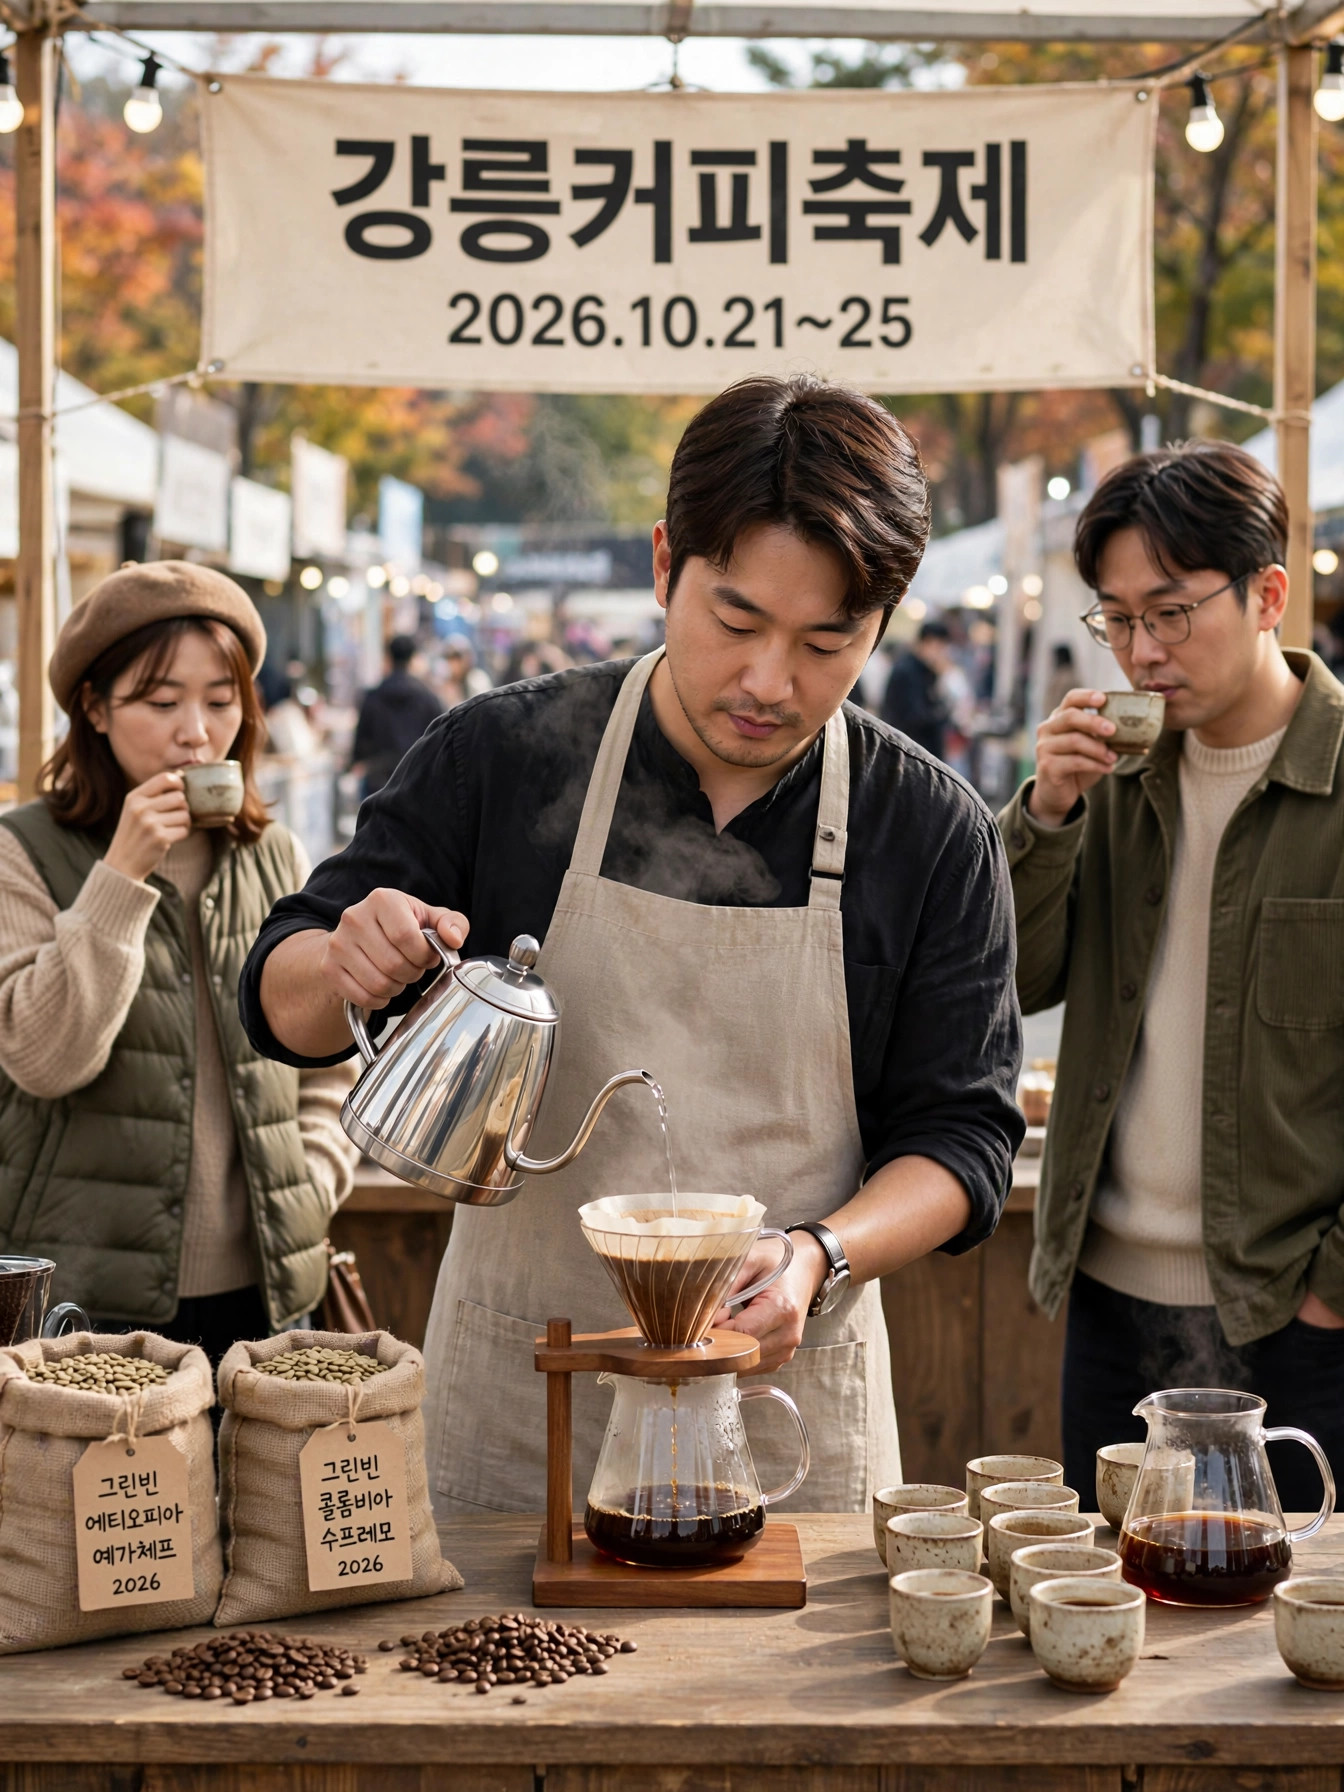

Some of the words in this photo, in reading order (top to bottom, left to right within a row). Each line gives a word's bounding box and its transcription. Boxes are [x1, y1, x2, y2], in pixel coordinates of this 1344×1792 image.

[331, 135, 1028, 266] 강릉커피축제
[448, 292, 913, 349] 2026.10.21~25
[320, 1453, 380, 1483] 그린빈
[98, 1470, 159, 1499] 그린빈
[85, 1502, 184, 1533] 에티오피아
[318, 1488, 394, 1522] 콜롬비아
[92, 1538, 177, 1566] 예가체프
[320, 1521, 395, 1553] 수프레모
[338, 1554, 384, 1577] 2026
[112, 1572, 161, 1596] 2026
